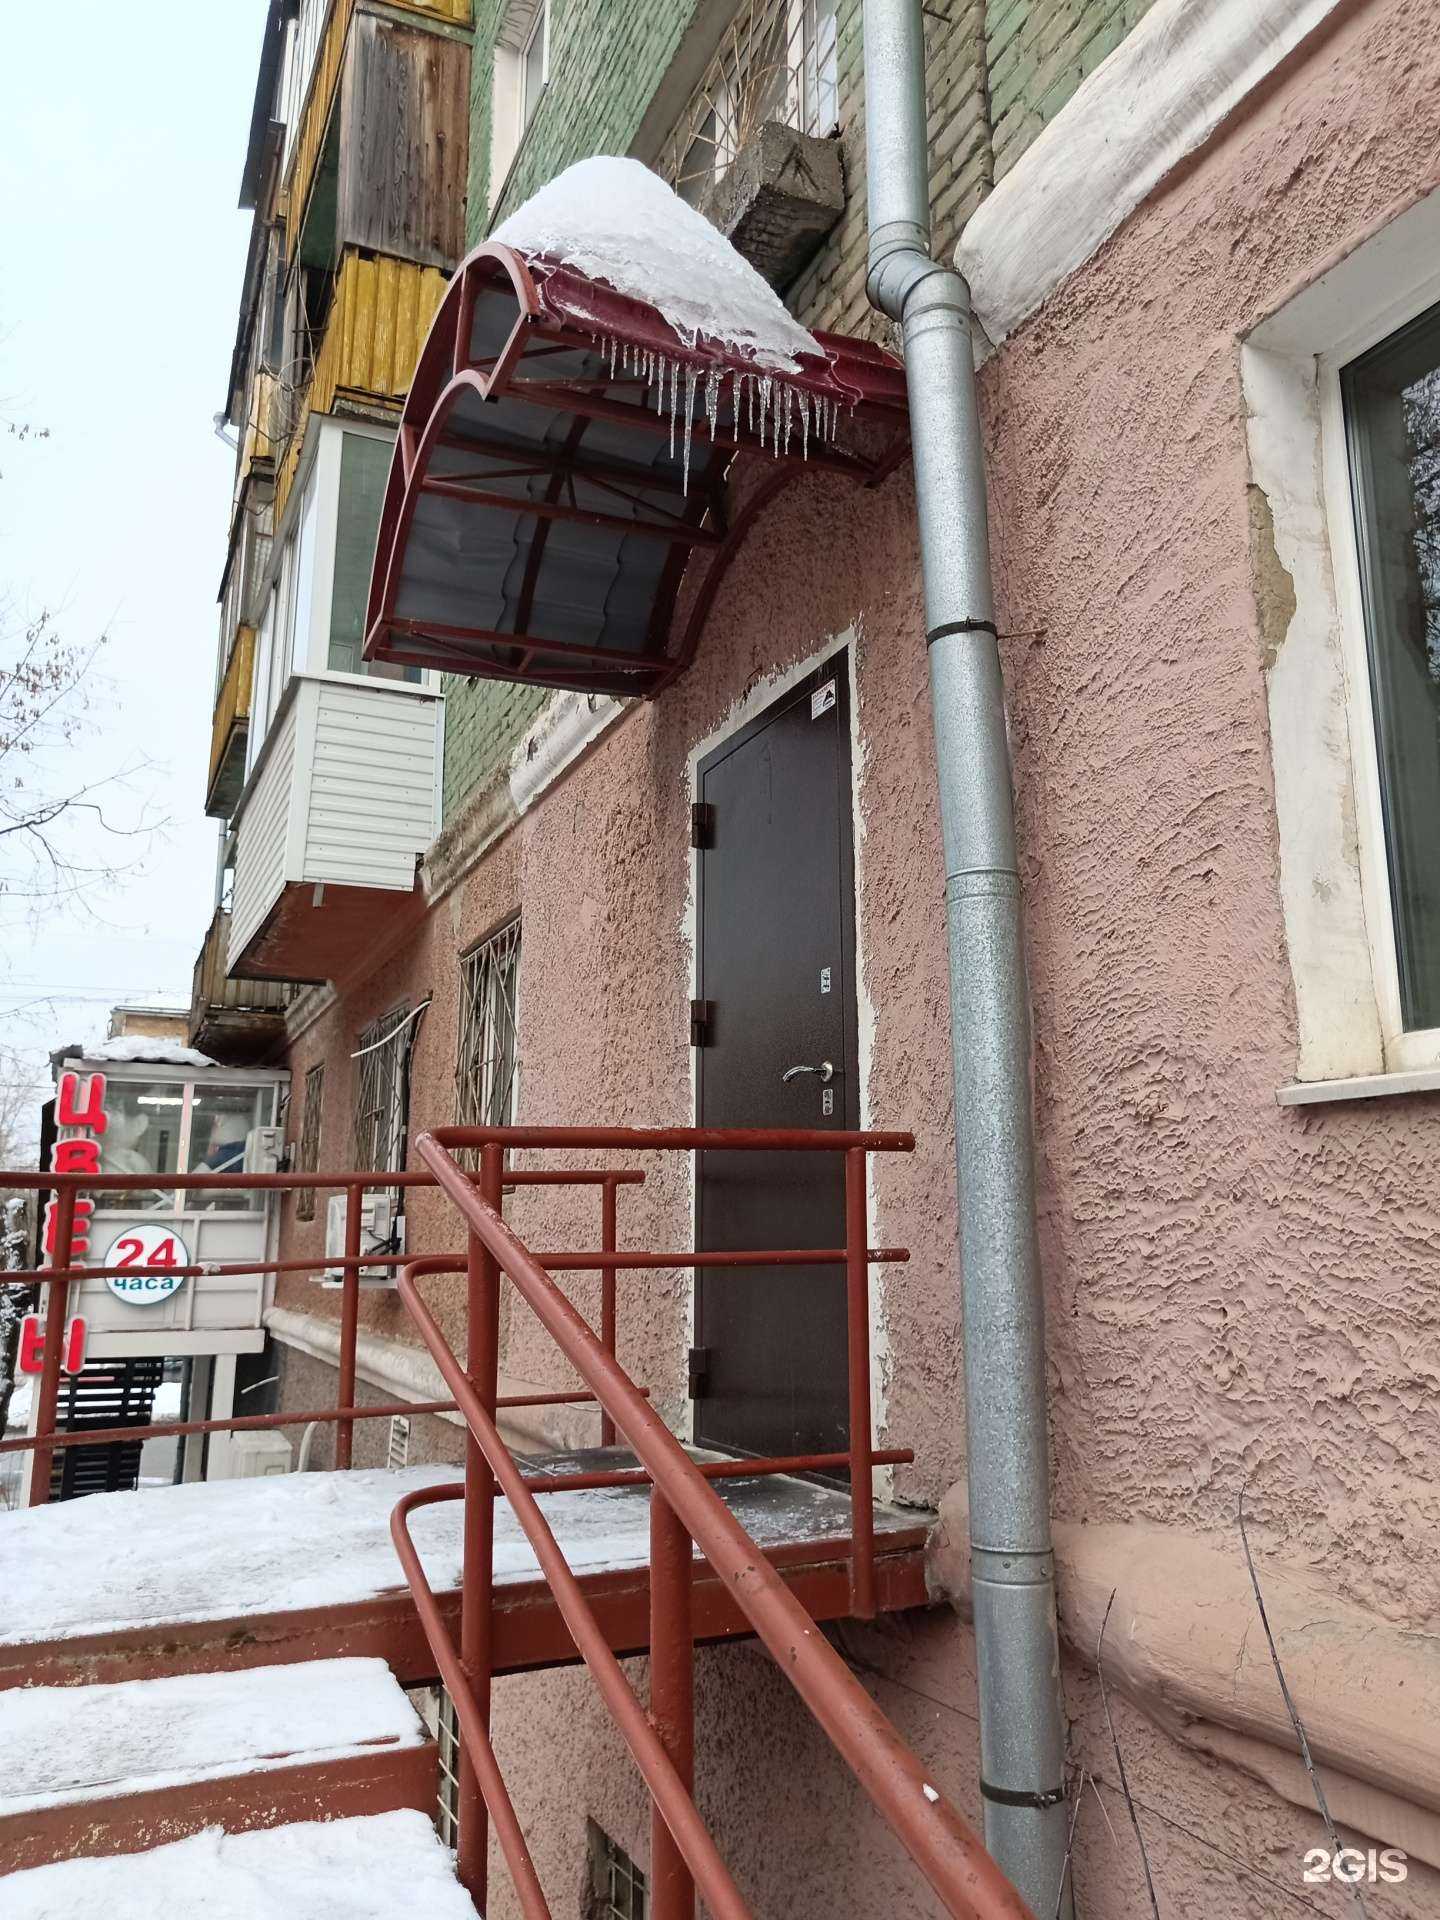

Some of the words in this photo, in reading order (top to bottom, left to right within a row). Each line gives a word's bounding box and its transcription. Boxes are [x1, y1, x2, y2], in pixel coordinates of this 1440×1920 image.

[20, 1073, 108, 1374] ЦВЕЫ
[116, 1238, 177, 1270] 24
[114, 1275, 174, 1291] часа
